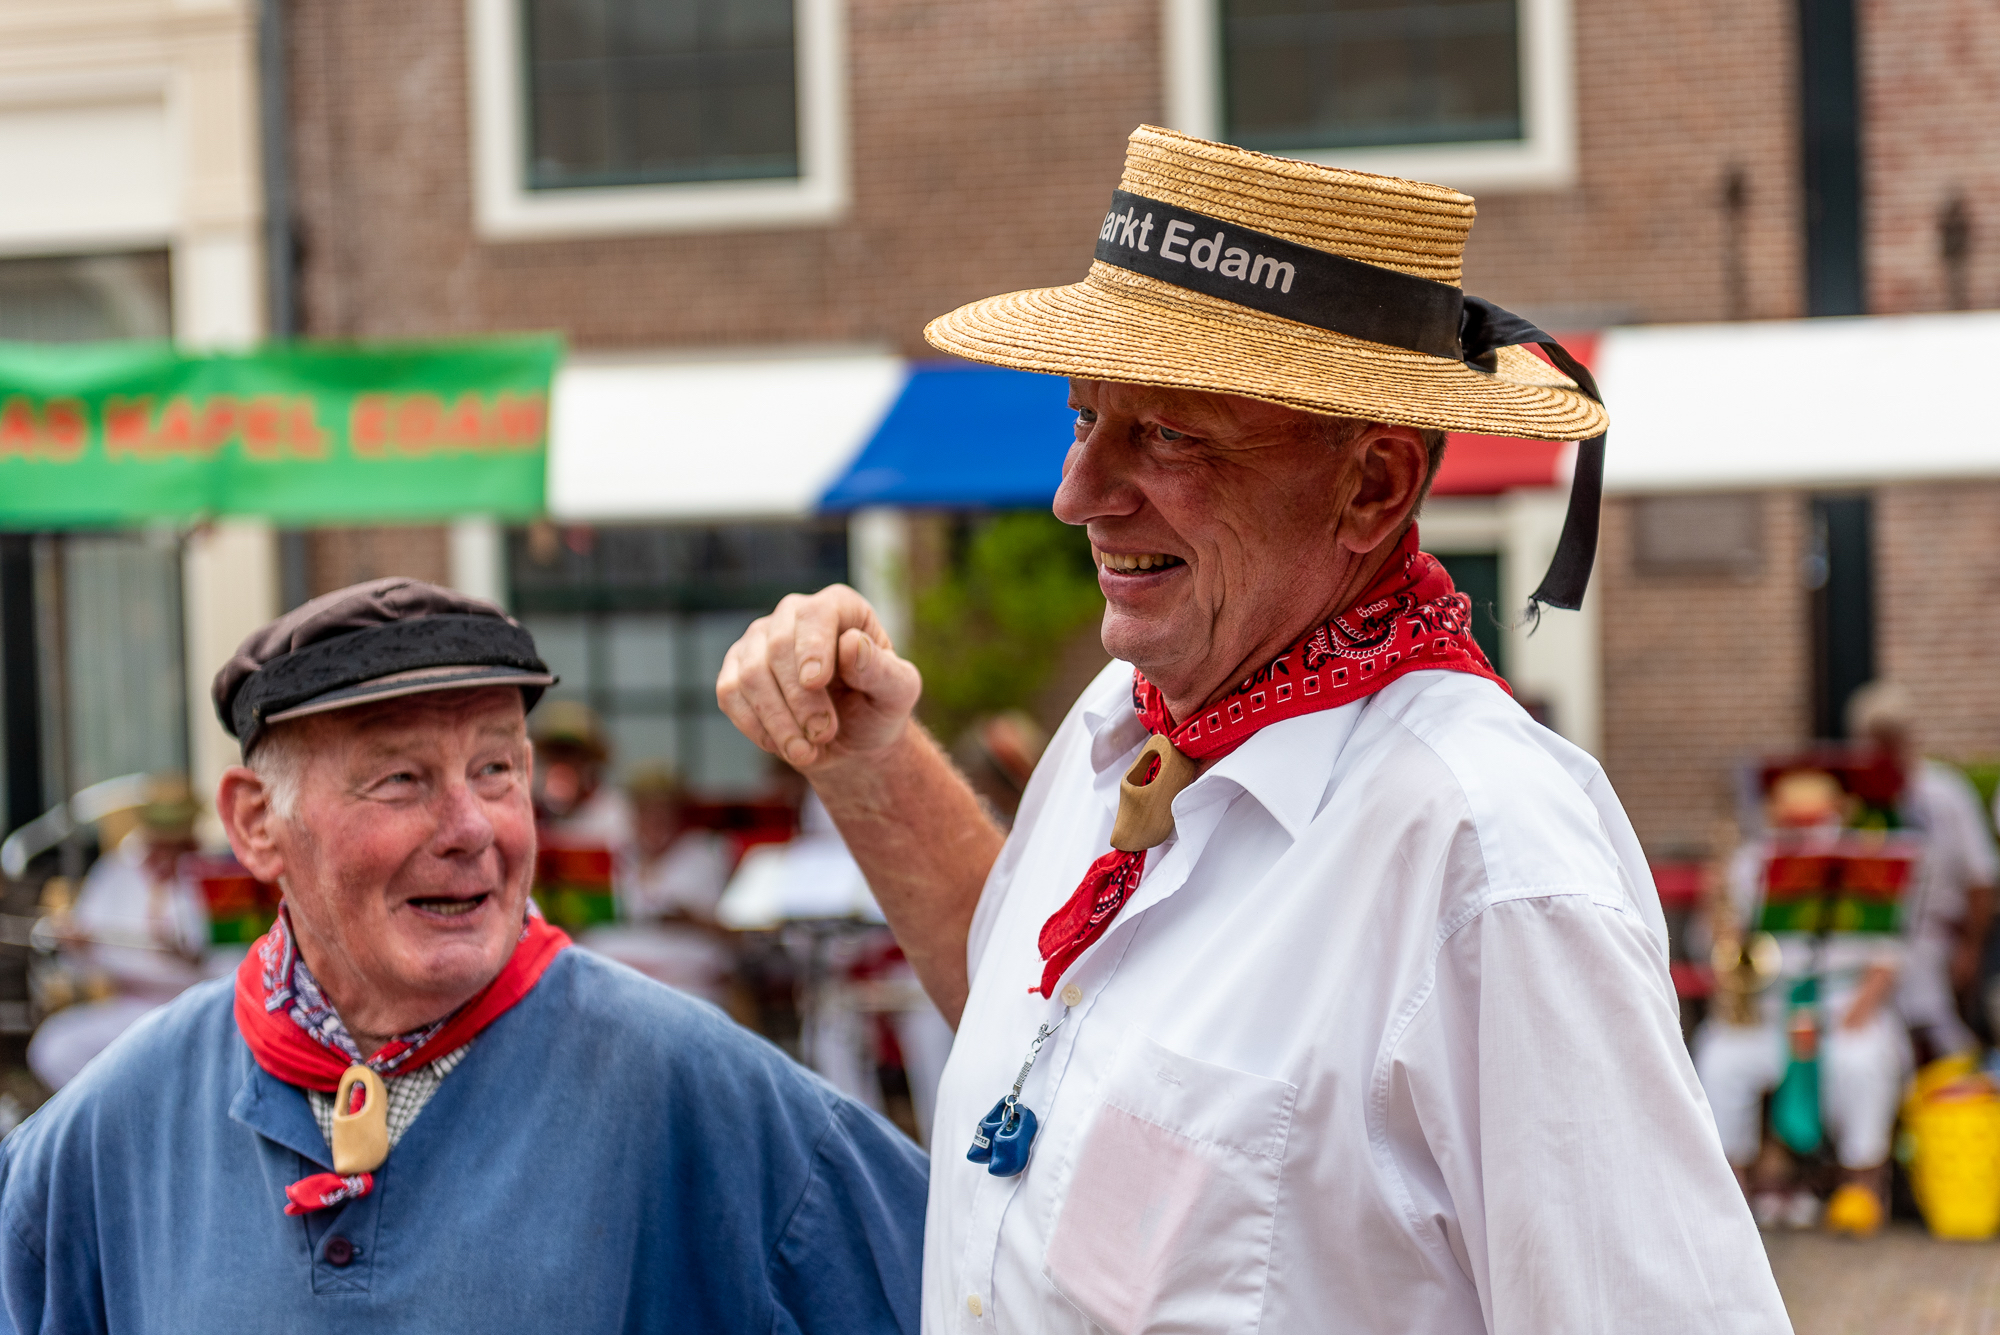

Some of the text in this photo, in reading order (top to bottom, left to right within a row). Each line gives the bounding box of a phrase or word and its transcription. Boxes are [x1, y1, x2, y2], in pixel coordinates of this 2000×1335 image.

[1098, 206, 1295, 294] arkt Edam
[104, 392, 331, 462] KAPEL
[351, 388, 547, 458] EDAM
